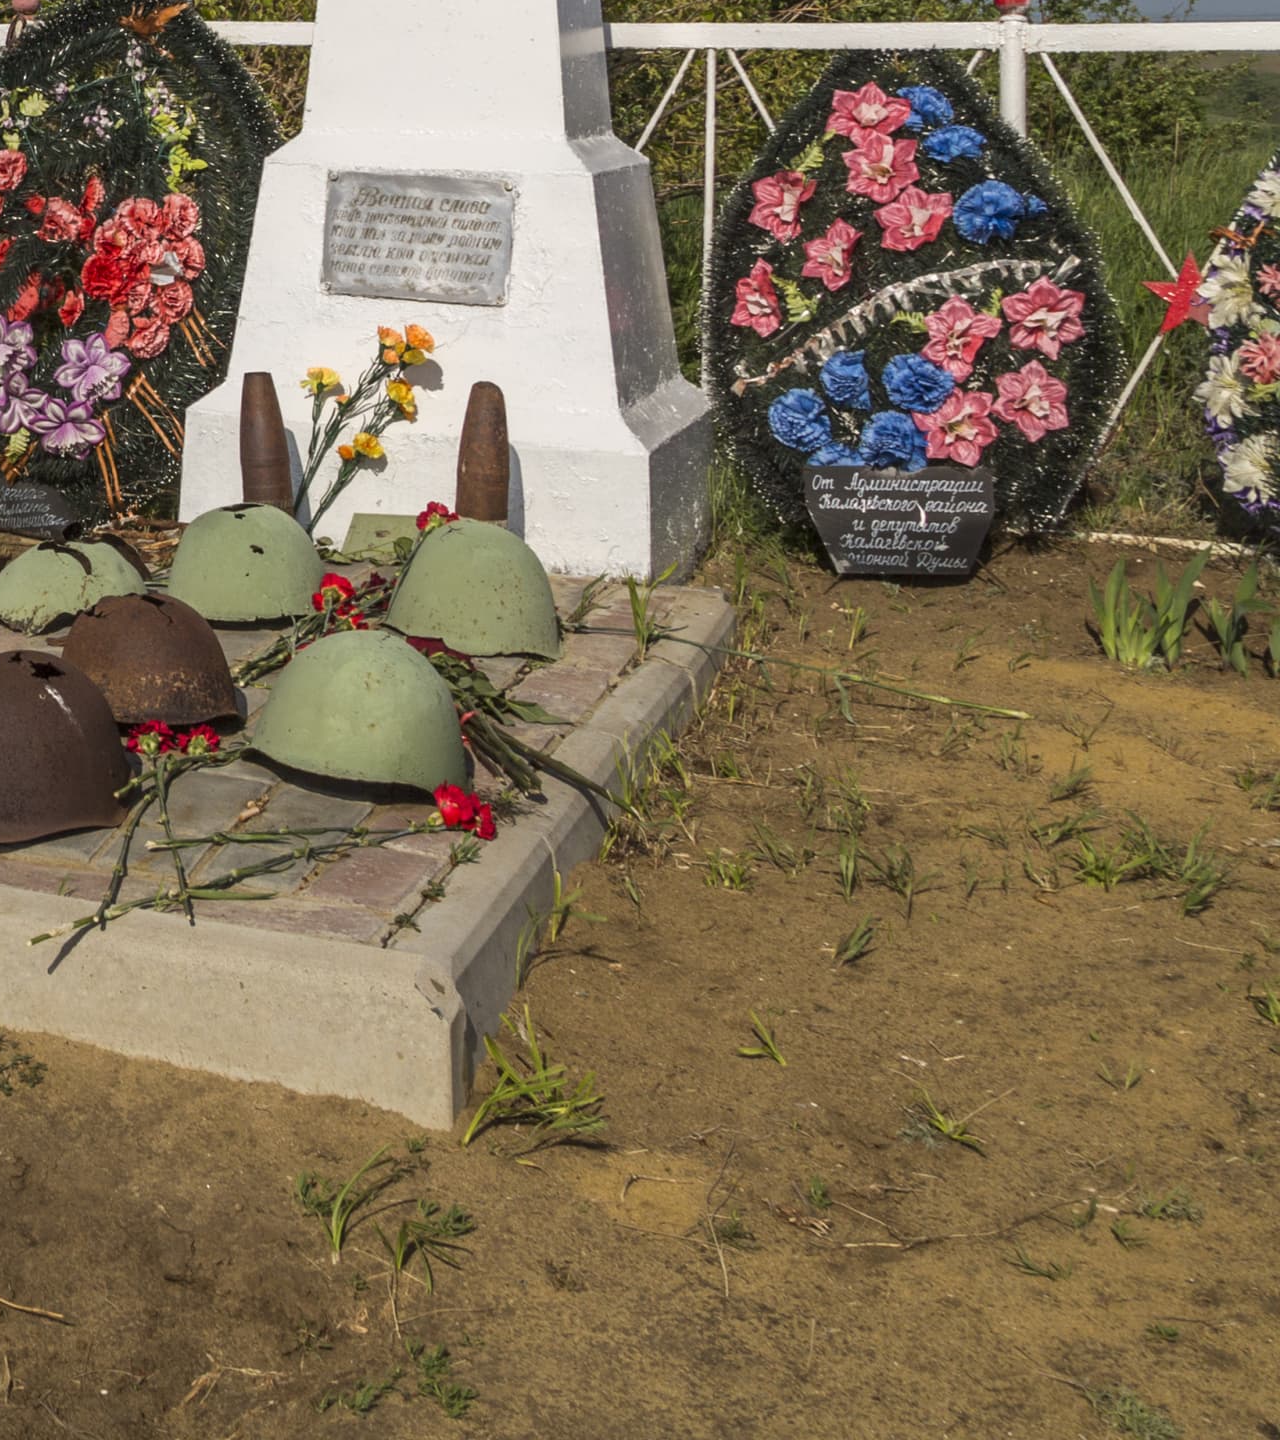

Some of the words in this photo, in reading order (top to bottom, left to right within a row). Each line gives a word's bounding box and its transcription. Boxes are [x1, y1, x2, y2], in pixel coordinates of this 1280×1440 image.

[812, 475, 834, 490] От
[844, 472, 984, 497] Администрации
[852, 520, 864, 531] и
[917, 553, 968, 573] Думы
